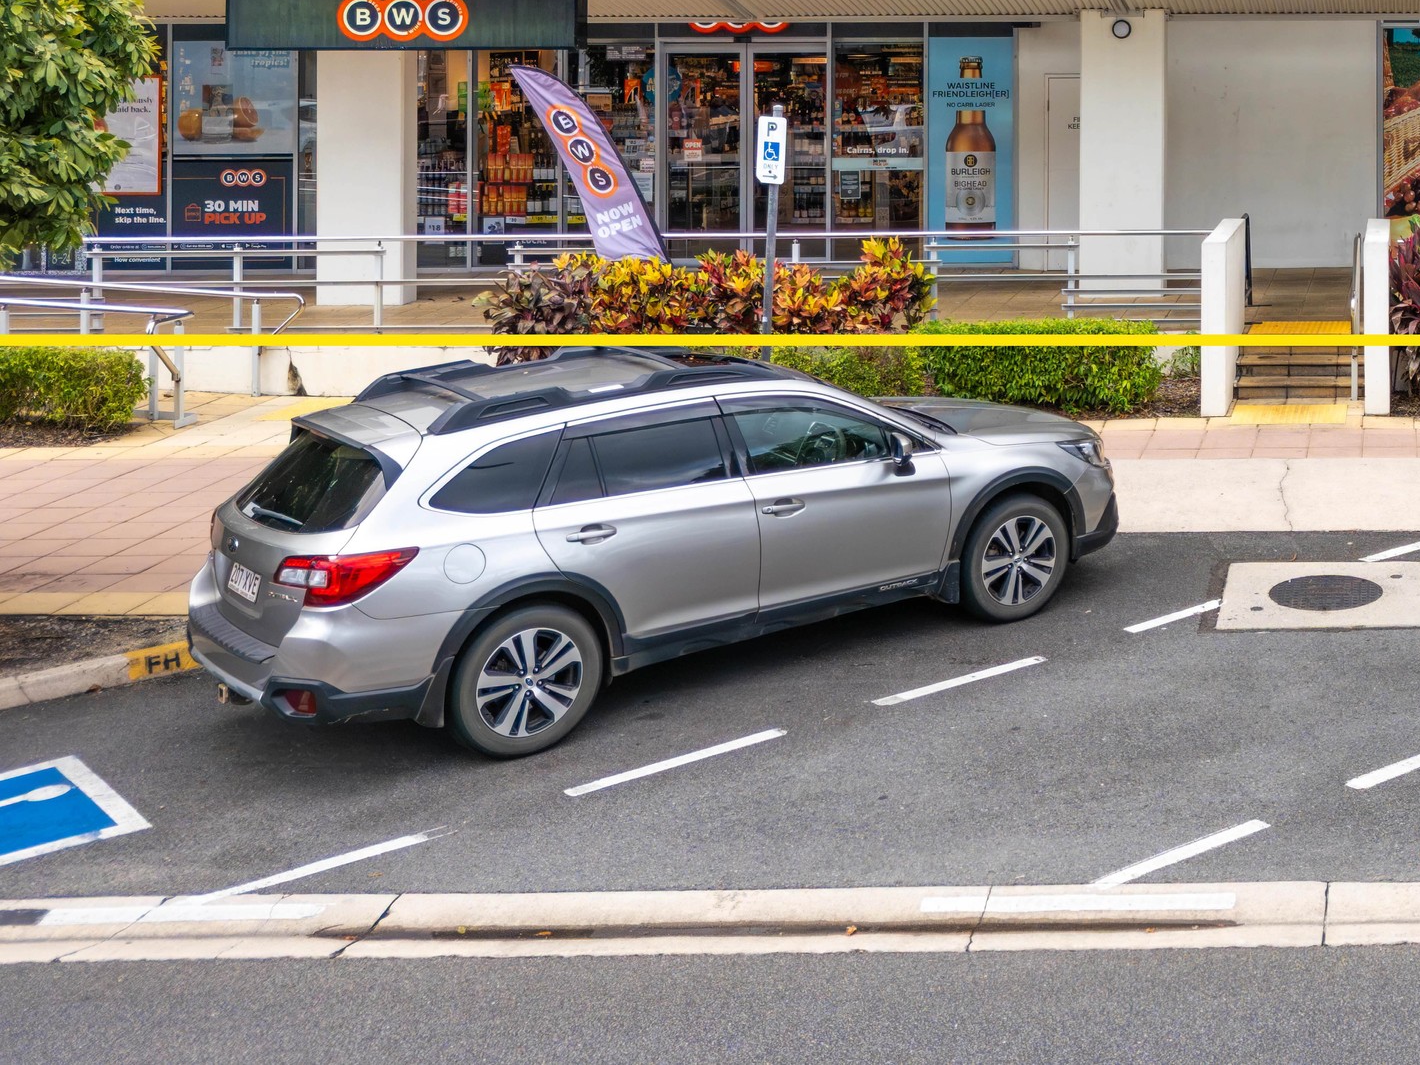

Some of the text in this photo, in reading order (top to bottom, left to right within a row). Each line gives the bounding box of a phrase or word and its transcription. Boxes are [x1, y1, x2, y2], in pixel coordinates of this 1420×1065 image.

[355, 7, 452, 26] BWS
[251, 56, 288, 67] tropics!
[947, 82, 995, 90] WAISTLINE
[932, 90, 1010, 99] FRIENDLEIGH[ER]
[117, 104, 129, 113] aid
[767, 121, 778, 137] P
[847, 146, 875, 154] Cairns,
[877, 146, 897, 154] drop
[763, 163, 779, 171] ONLY
[951, 167, 991, 176] BURLEIGH
[226, 173, 261, 182] BWS
[954, 180, 987, 188] BIGHEAD
[204, 200, 259, 212] 30 MIN
[135, 207, 157, 215] time,
[596, 201, 635, 225] NOW
[115, 216, 167, 224] skip the line.
[204, 212, 241, 224] PICK
[244, 212, 267, 224] UP
[597, 214, 643, 239] OPEN
[879, 578, 919, 592] OUTBACK
[145, 652, 181, 674] FH
